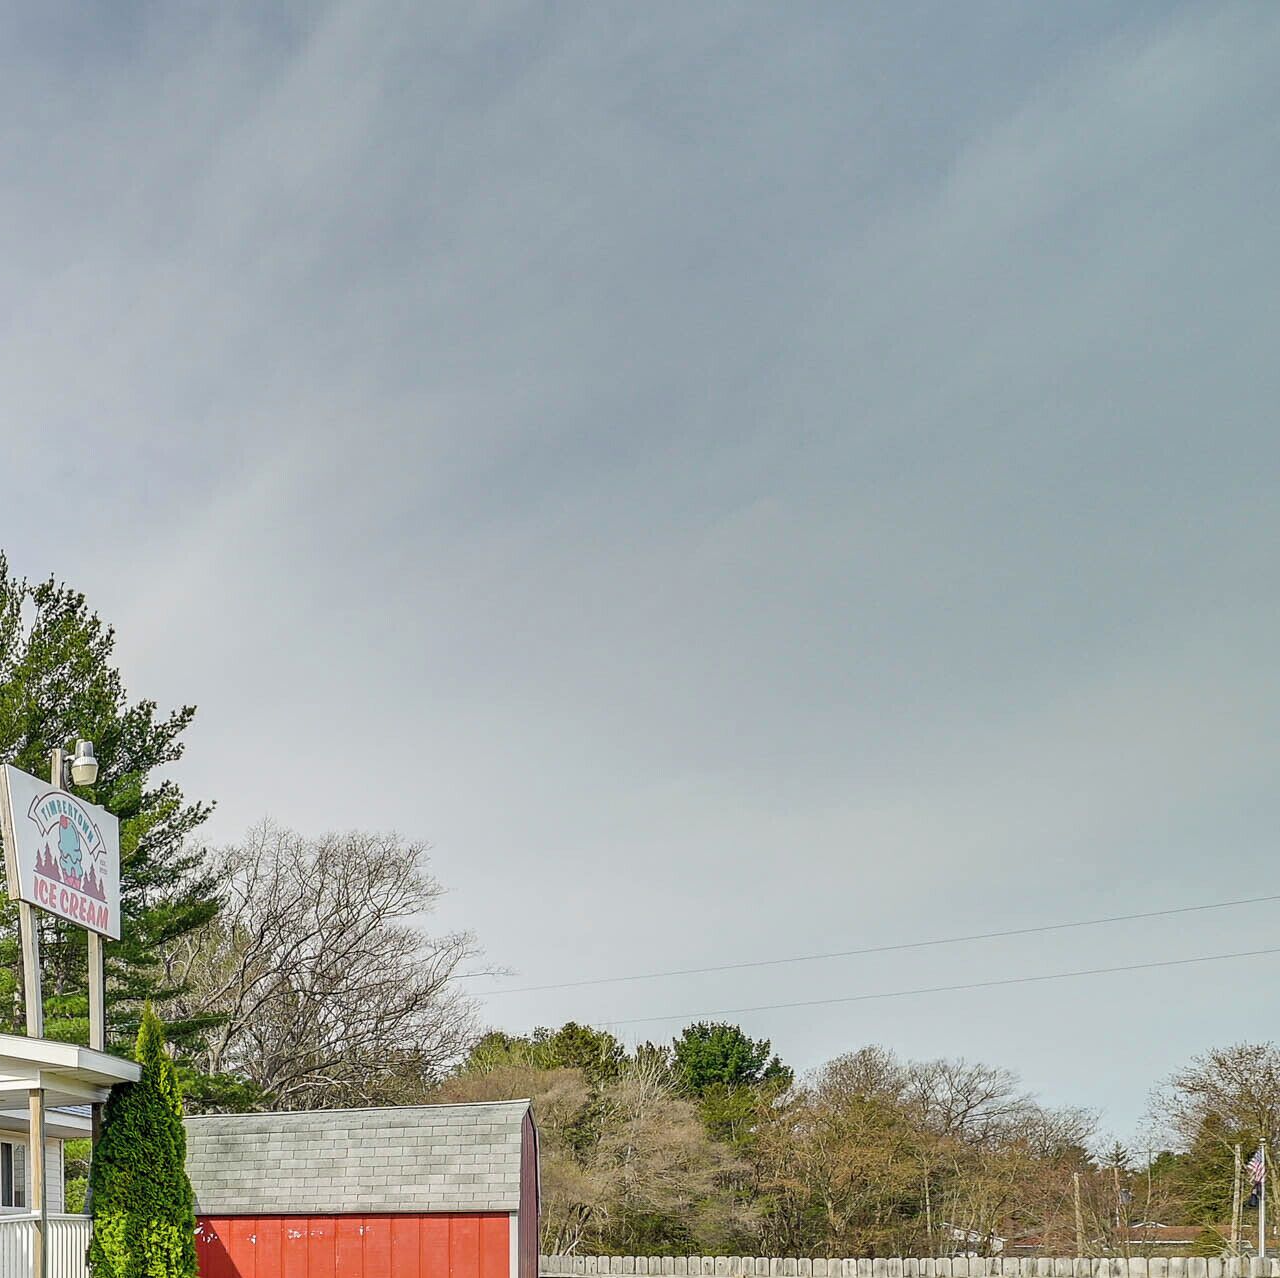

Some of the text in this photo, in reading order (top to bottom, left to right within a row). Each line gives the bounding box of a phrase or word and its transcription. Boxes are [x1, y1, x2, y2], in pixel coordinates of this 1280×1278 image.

[41, 799, 94, 843] TIMBERTOWN
[33, 876, 109, 931] ICE CREAM
